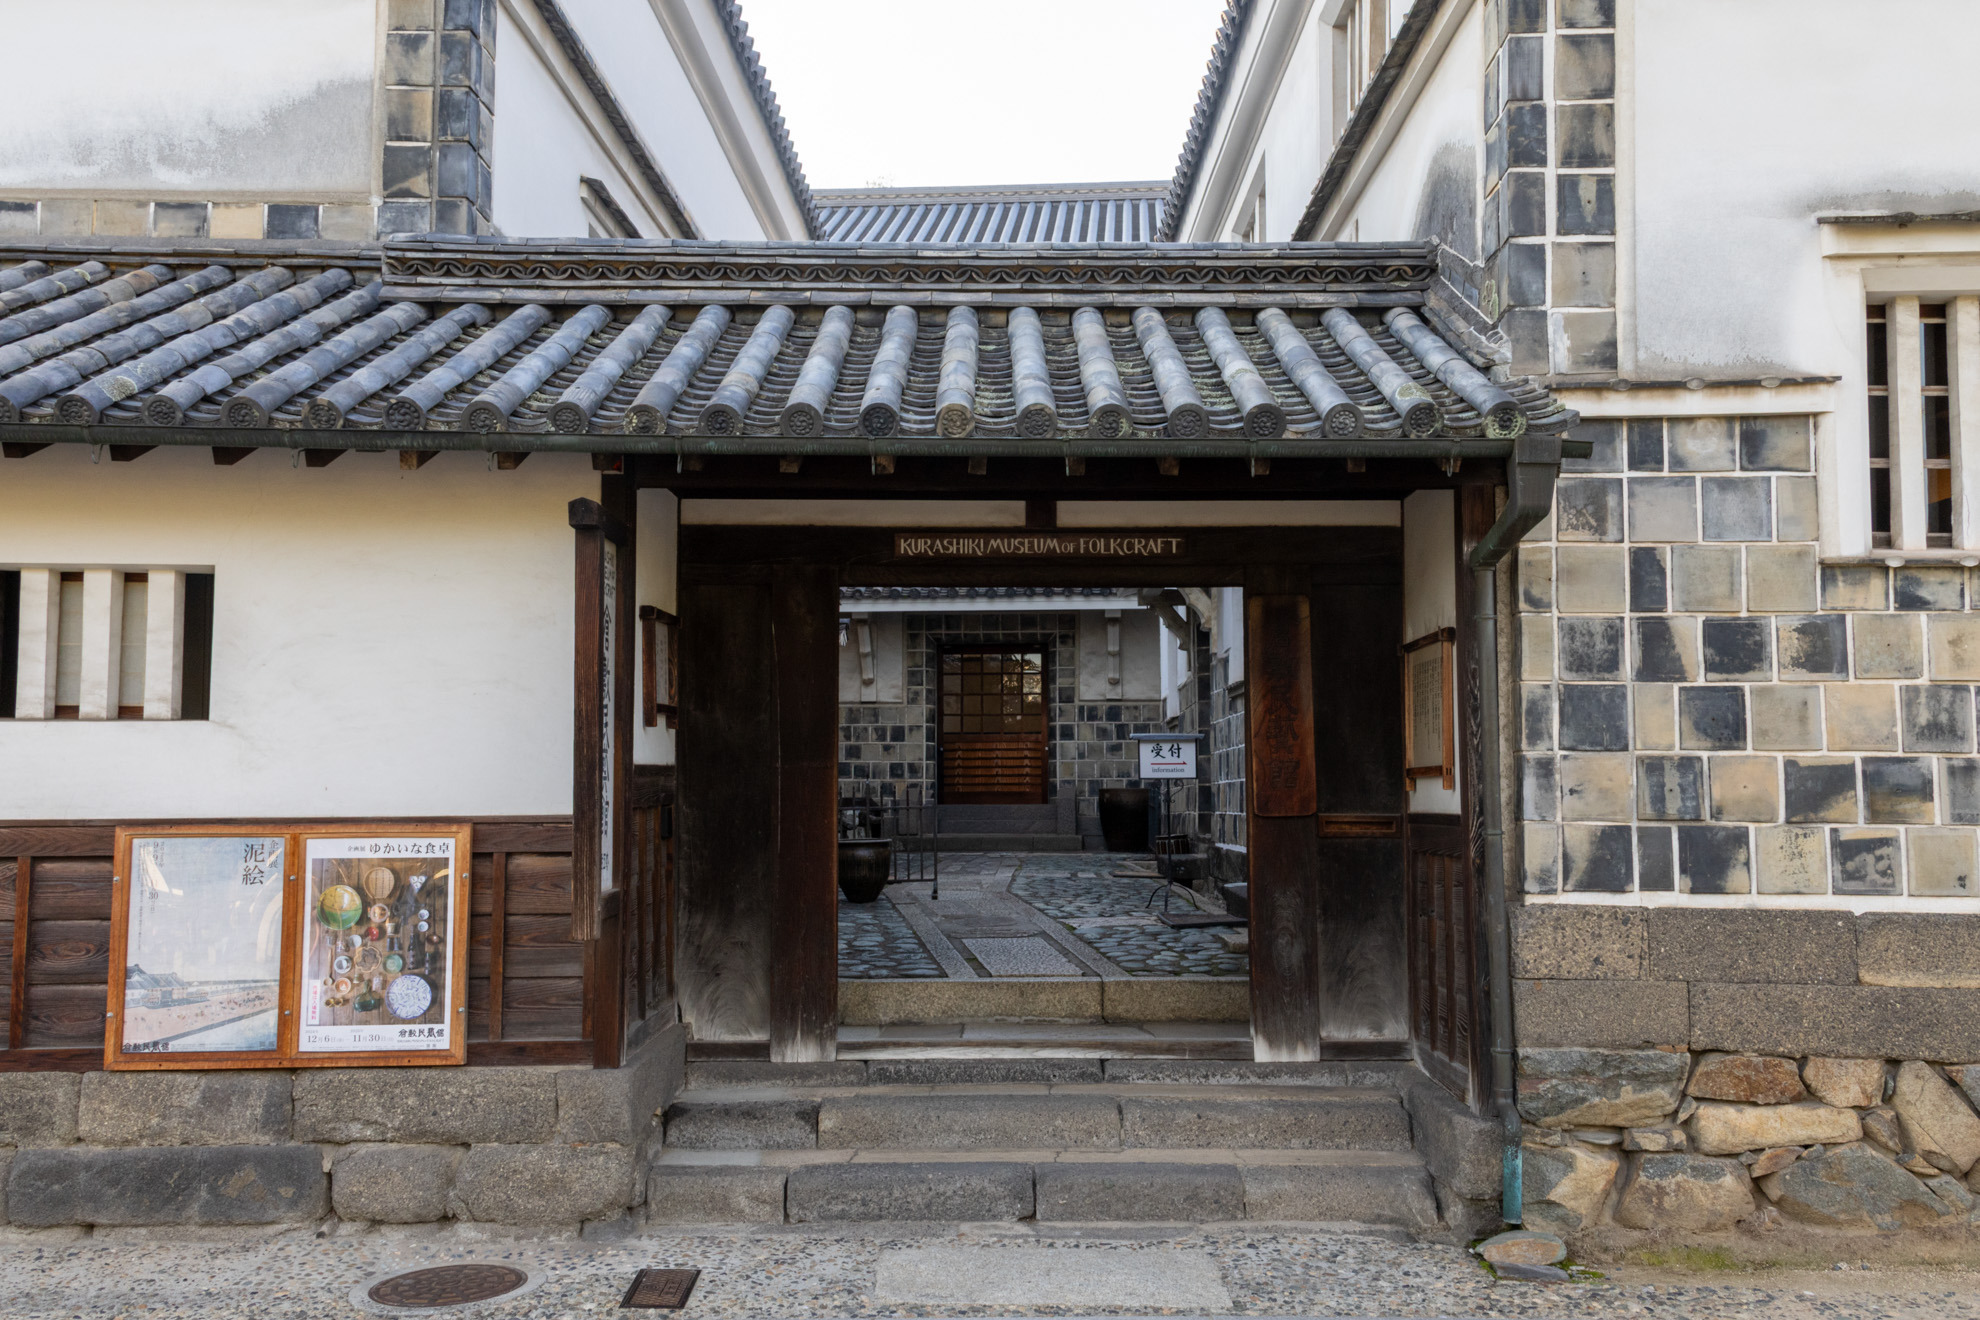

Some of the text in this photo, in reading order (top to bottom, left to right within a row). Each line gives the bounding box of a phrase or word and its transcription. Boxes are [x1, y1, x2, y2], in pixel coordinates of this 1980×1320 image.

[900, 538, 984, 556] KURASHIKI
[986, 538, 1060, 554] MUSEUM
[1080, 538, 1183, 556] FOLKCRAFT
[1151, 742, 1182, 759] 受付
[369, 842, 450, 855] ゆかいな食卓
[242, 843, 265, 886] 泥絵
